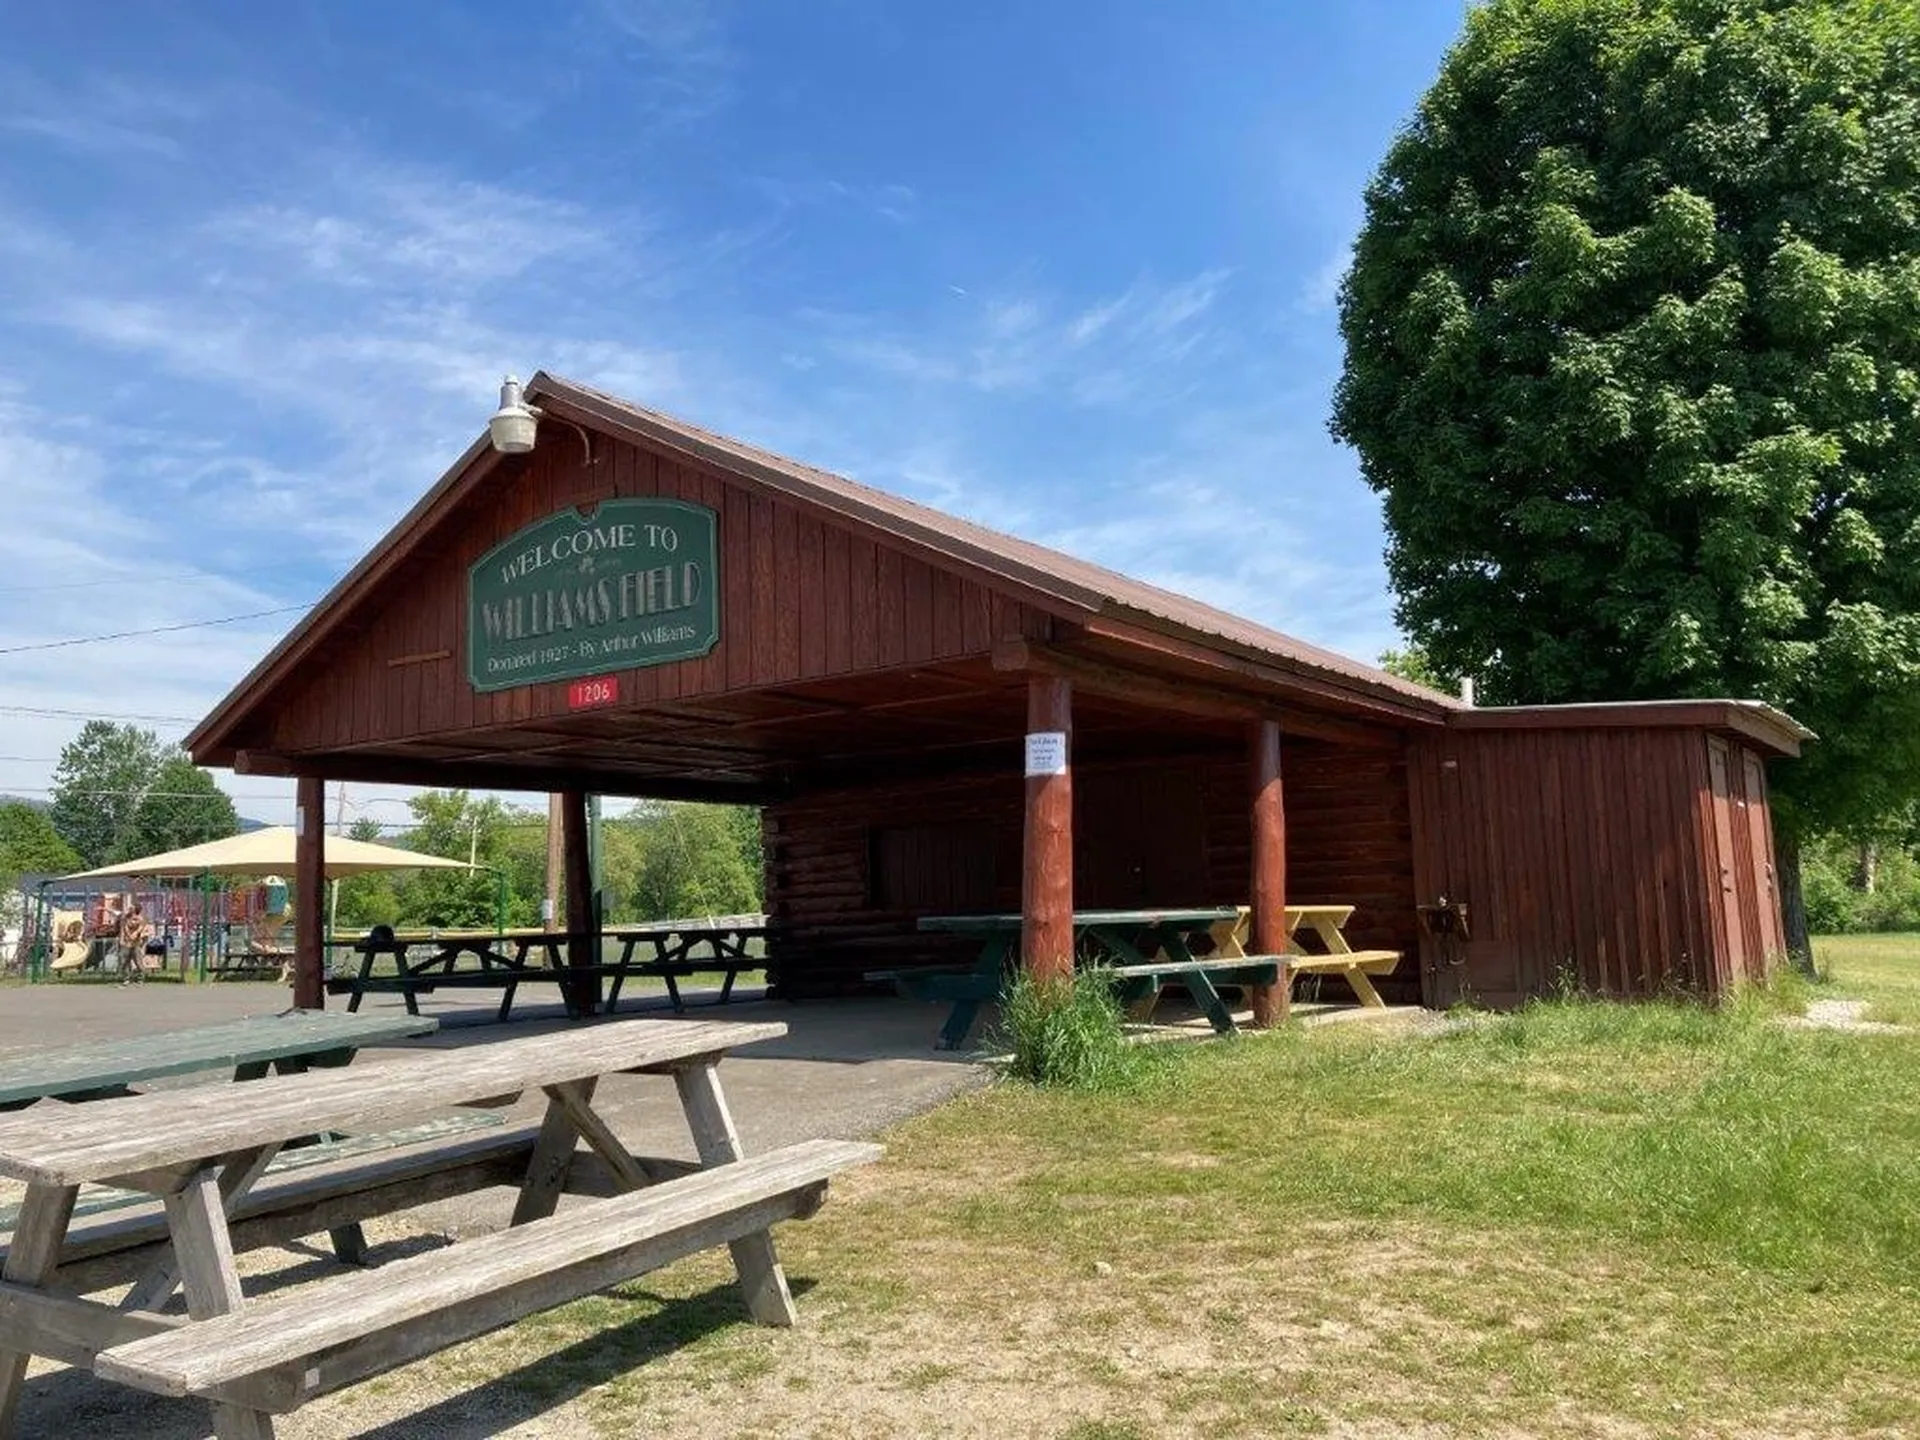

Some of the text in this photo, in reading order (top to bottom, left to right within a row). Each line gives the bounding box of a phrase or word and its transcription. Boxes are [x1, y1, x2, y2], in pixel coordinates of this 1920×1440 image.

[502, 524, 678, 583] WELCOME TO
[482, 561, 702, 640] WILLIAMS FIELD
[640, 625, 696, 645] Williams
[578, 683, 610, 703] 1206
